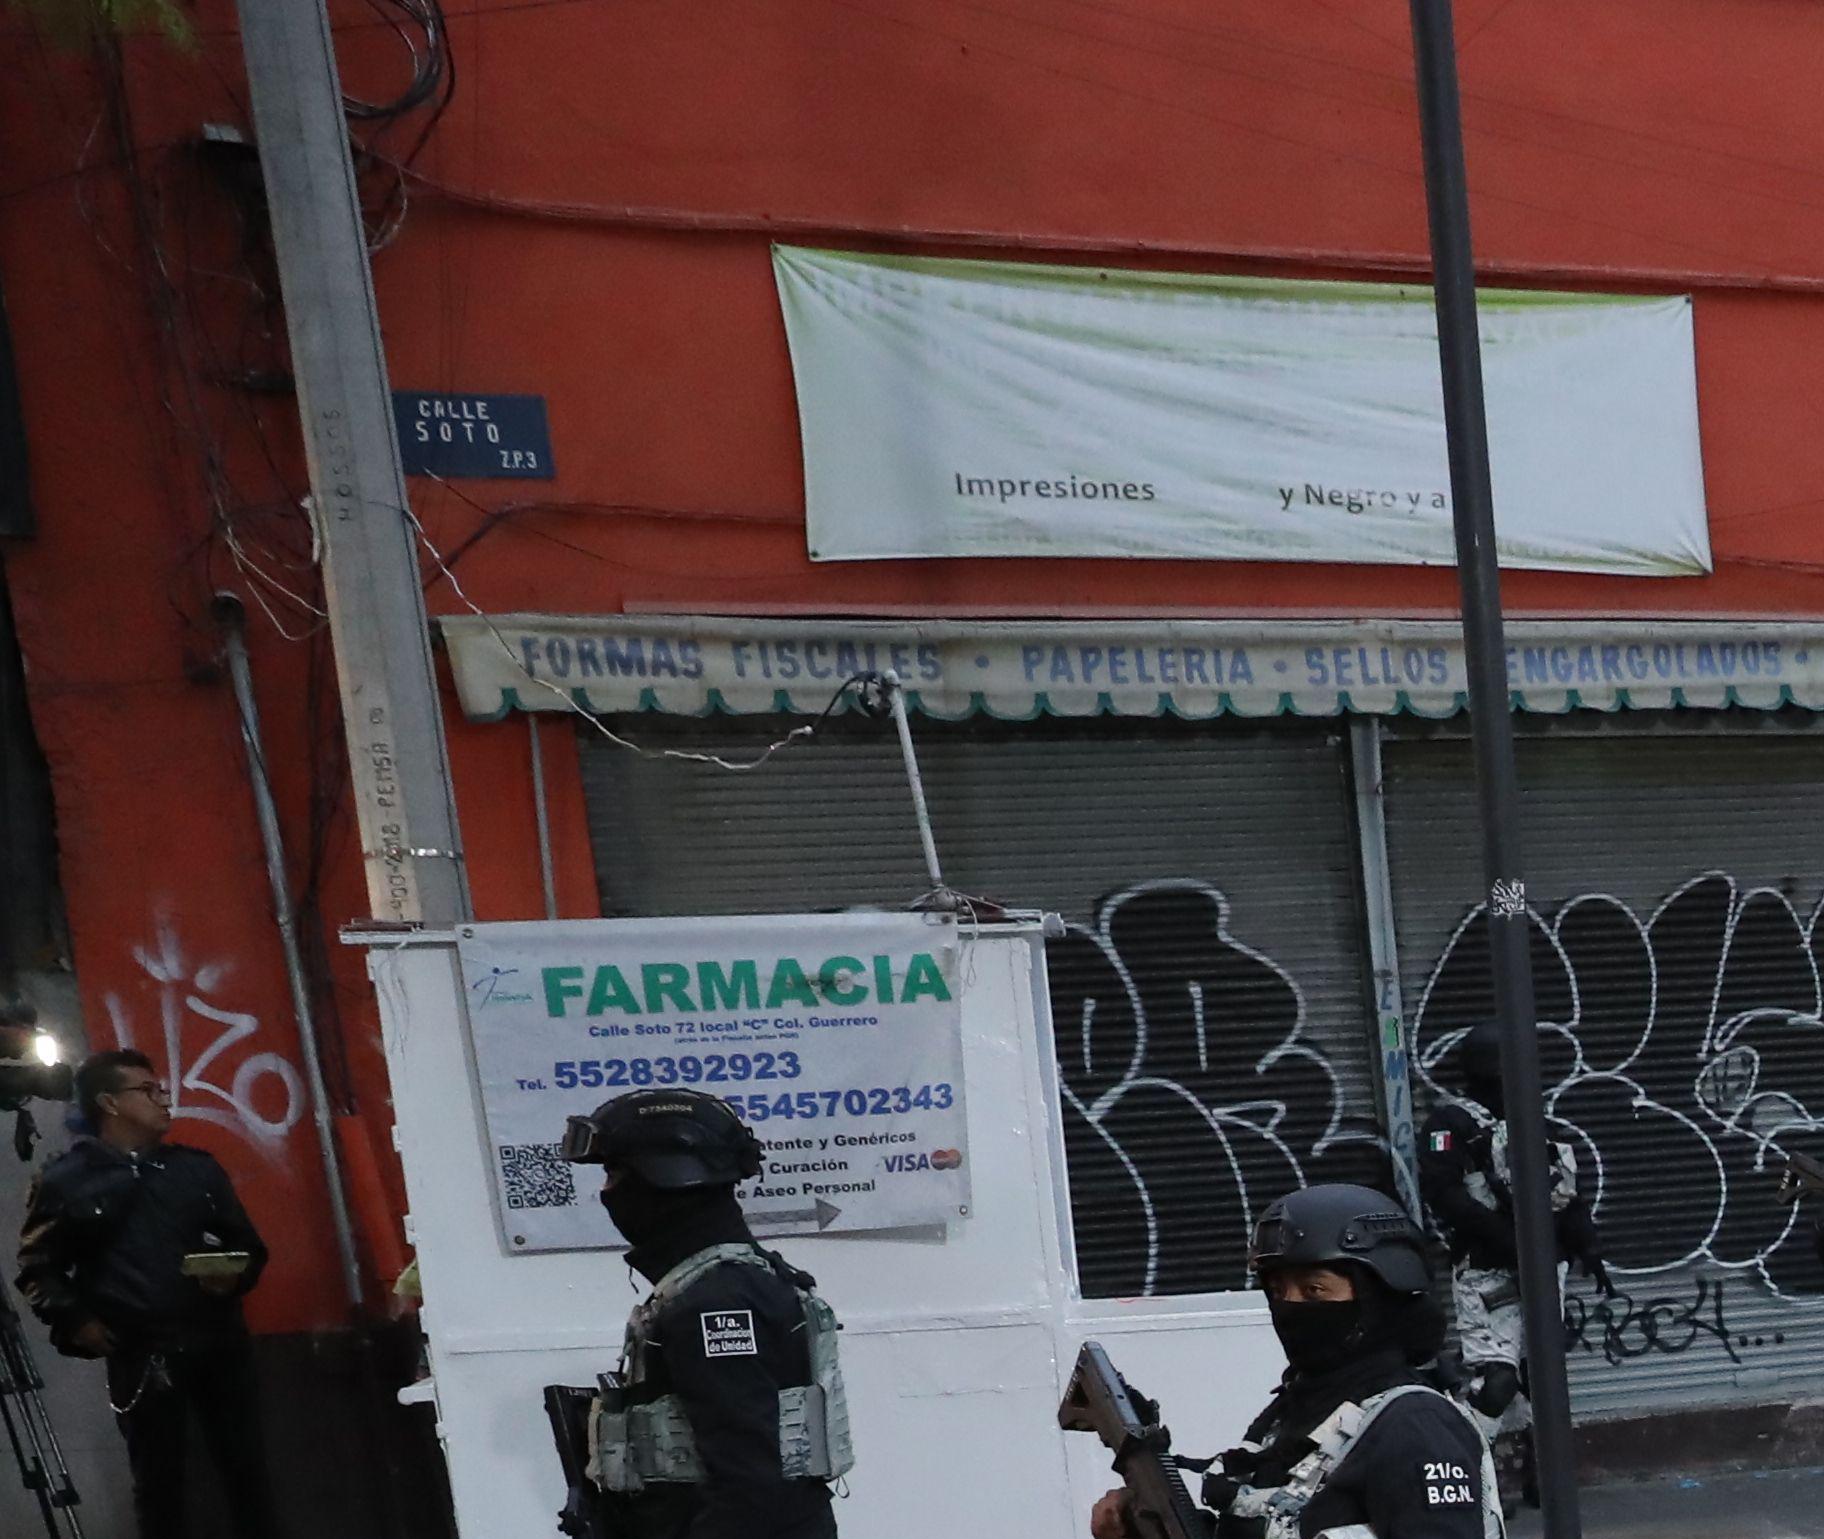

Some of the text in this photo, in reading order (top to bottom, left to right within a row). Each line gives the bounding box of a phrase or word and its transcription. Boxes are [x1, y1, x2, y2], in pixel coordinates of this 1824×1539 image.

[418, 399, 491, 420] CALLE
[415, 420, 500, 443] SOTO
[954, 472, 1157, 503] Impresiones
[520, 636, 704, 680] FORMAS
[730, 640, 942, 681] FISCALES
[1022, 645, 1254, 685] PAPELERIA
[1304, 647, 1449, 685] SELLOS
[541, 953, 953, 1017] FARMACIA
[588, 1024, 630, 1038] Calle
[634, 1023, 671, 1036] Soto
[676, 1022, 696, 1034] 72
[700, 1020, 739, 1033] local
[773, 1016, 804, 1029] Col.
[808, 1015, 879, 1028] Guerrero
[518, 1051, 801, 1091] Tel. 5528392923
[818, 1137, 829, 1150] y
[834, 1131, 917, 1147] Genéricos
[769, 1153, 930, 1175] Curación VISA
[752, 1185, 797, 1199] Aseo
[802, 1179, 876, 1195] Personal
[1427, 1484, 1475, 1504] B.G.N.
